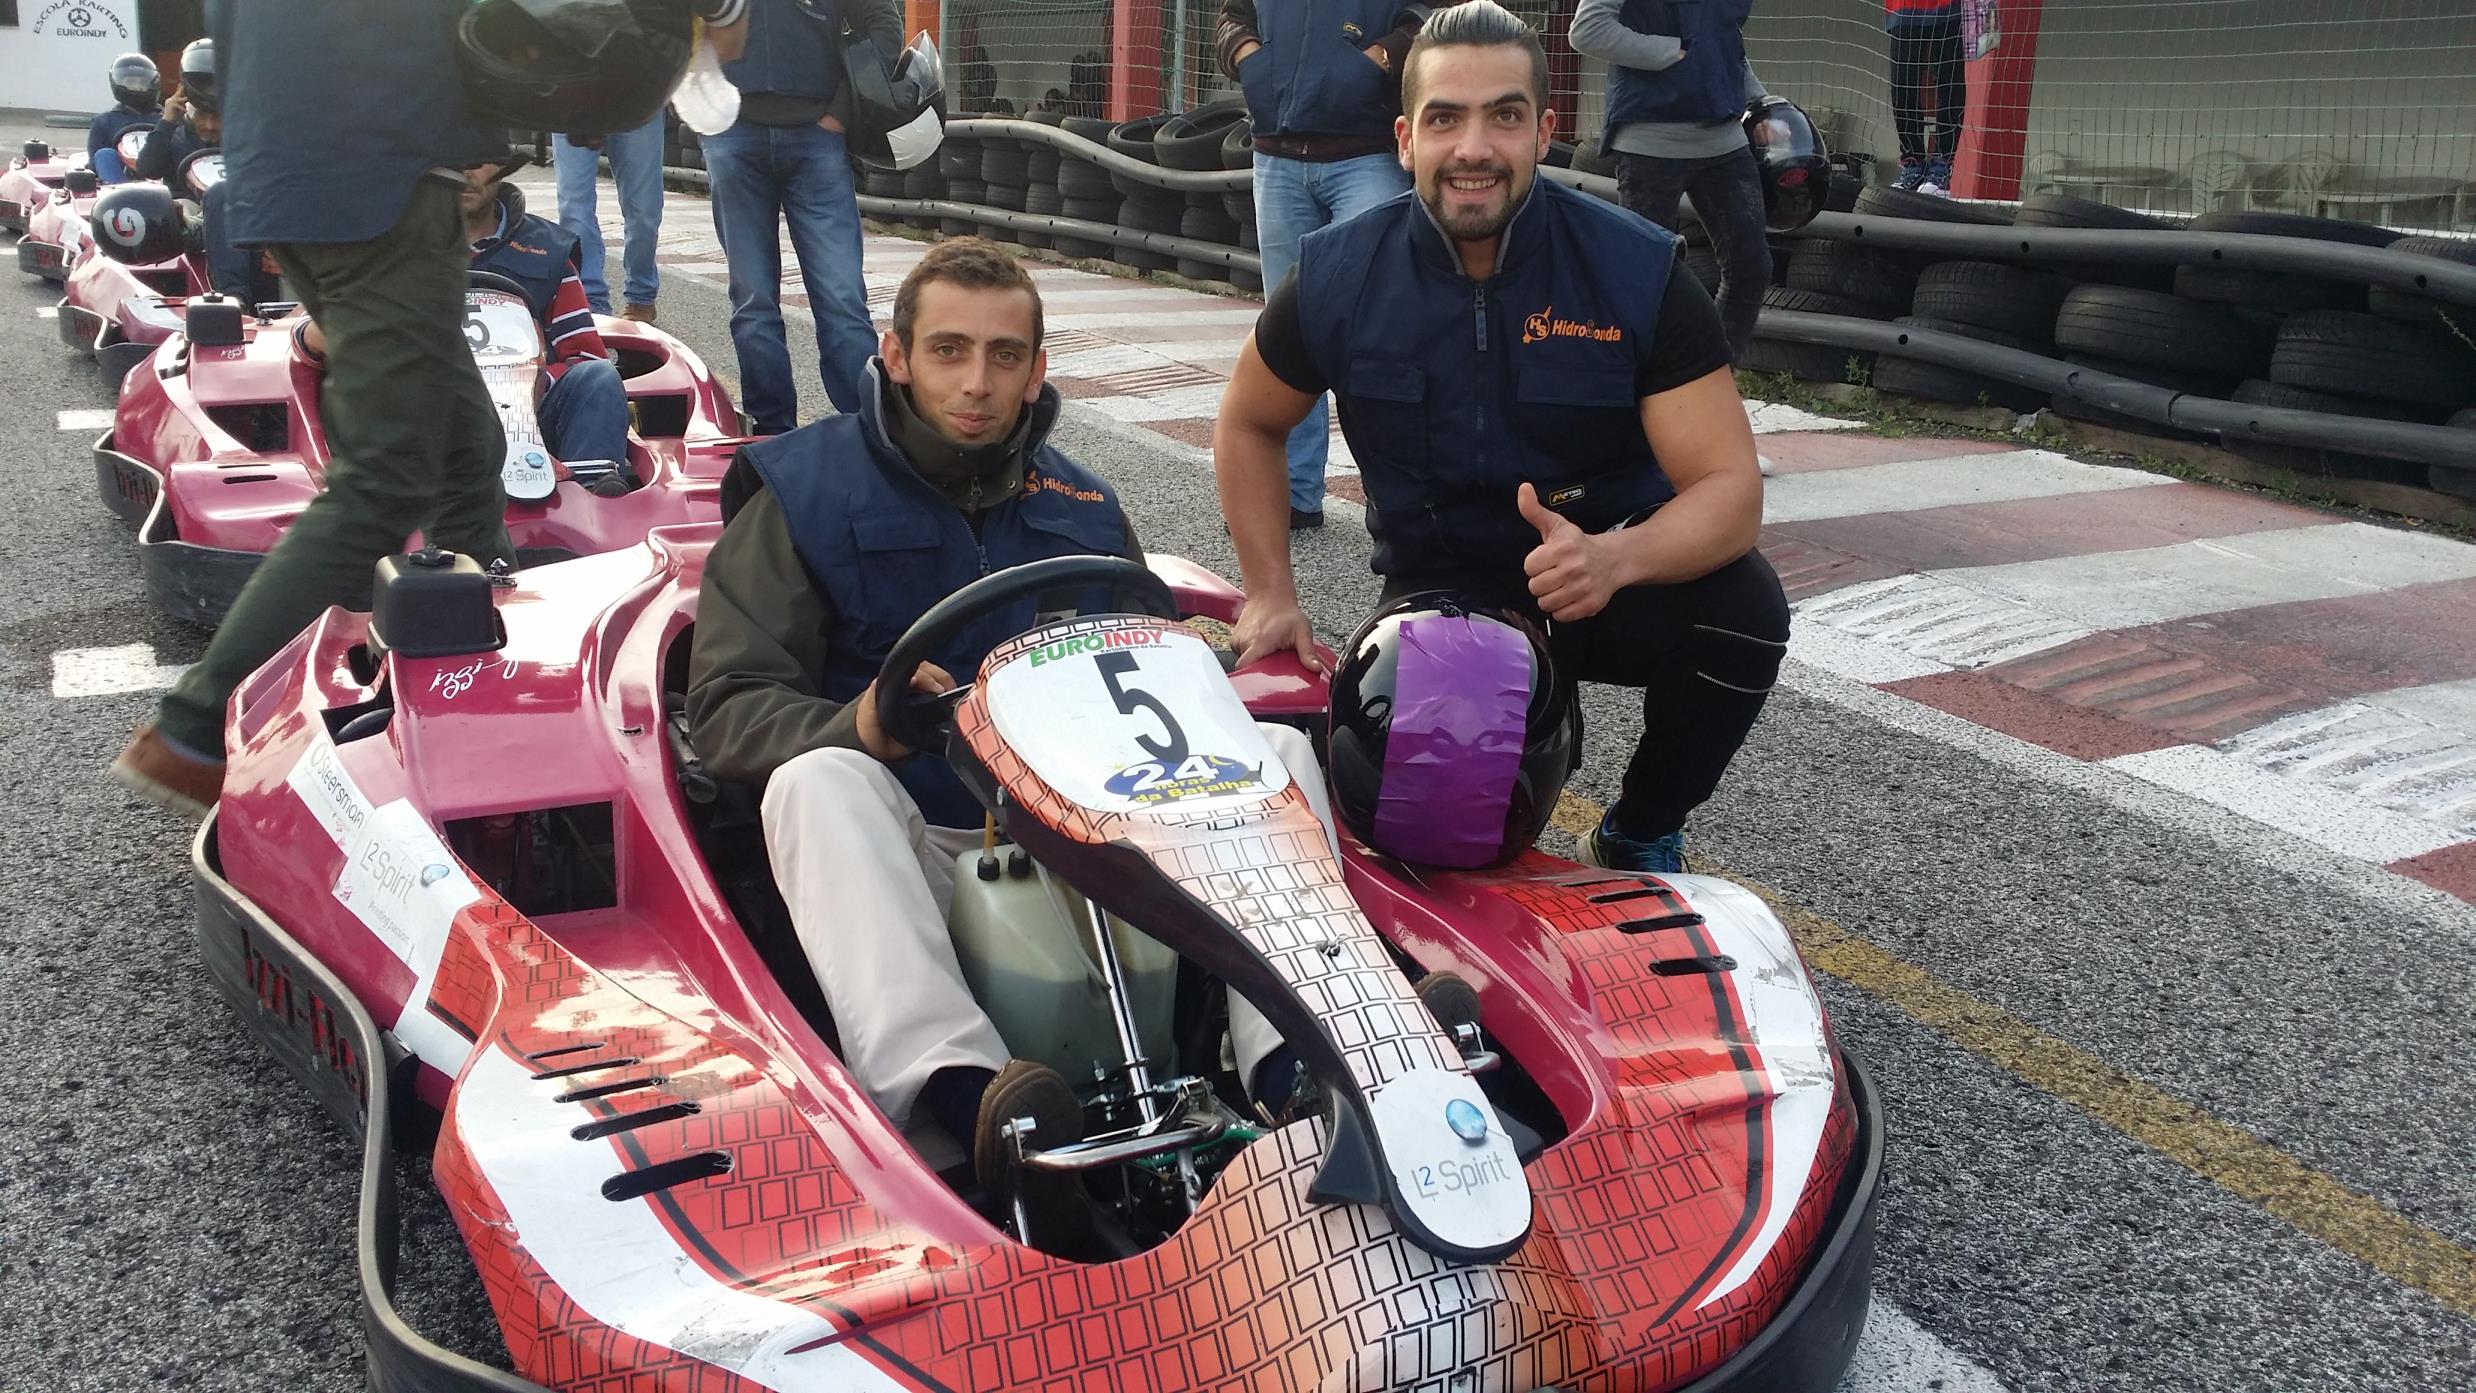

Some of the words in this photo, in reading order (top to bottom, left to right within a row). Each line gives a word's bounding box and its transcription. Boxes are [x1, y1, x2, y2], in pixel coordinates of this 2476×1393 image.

[33, 0, 71, 35] ESCOLA
[79, 0, 128, 39] KARTING
[462, 305, 490, 350] 5
[515, 469, 548, 484] Spirit
[1029, 630, 1164, 668] EUROINDY
[1093, 651, 1189, 763] 5
[1121, 755, 1220, 793] 24
[1134, 792, 1163, 804] da
[1167, 779, 1255, 799] Batalha
[372, 850, 416, 905] Spirit
[1438, 1151, 1511, 1197] Spirit
